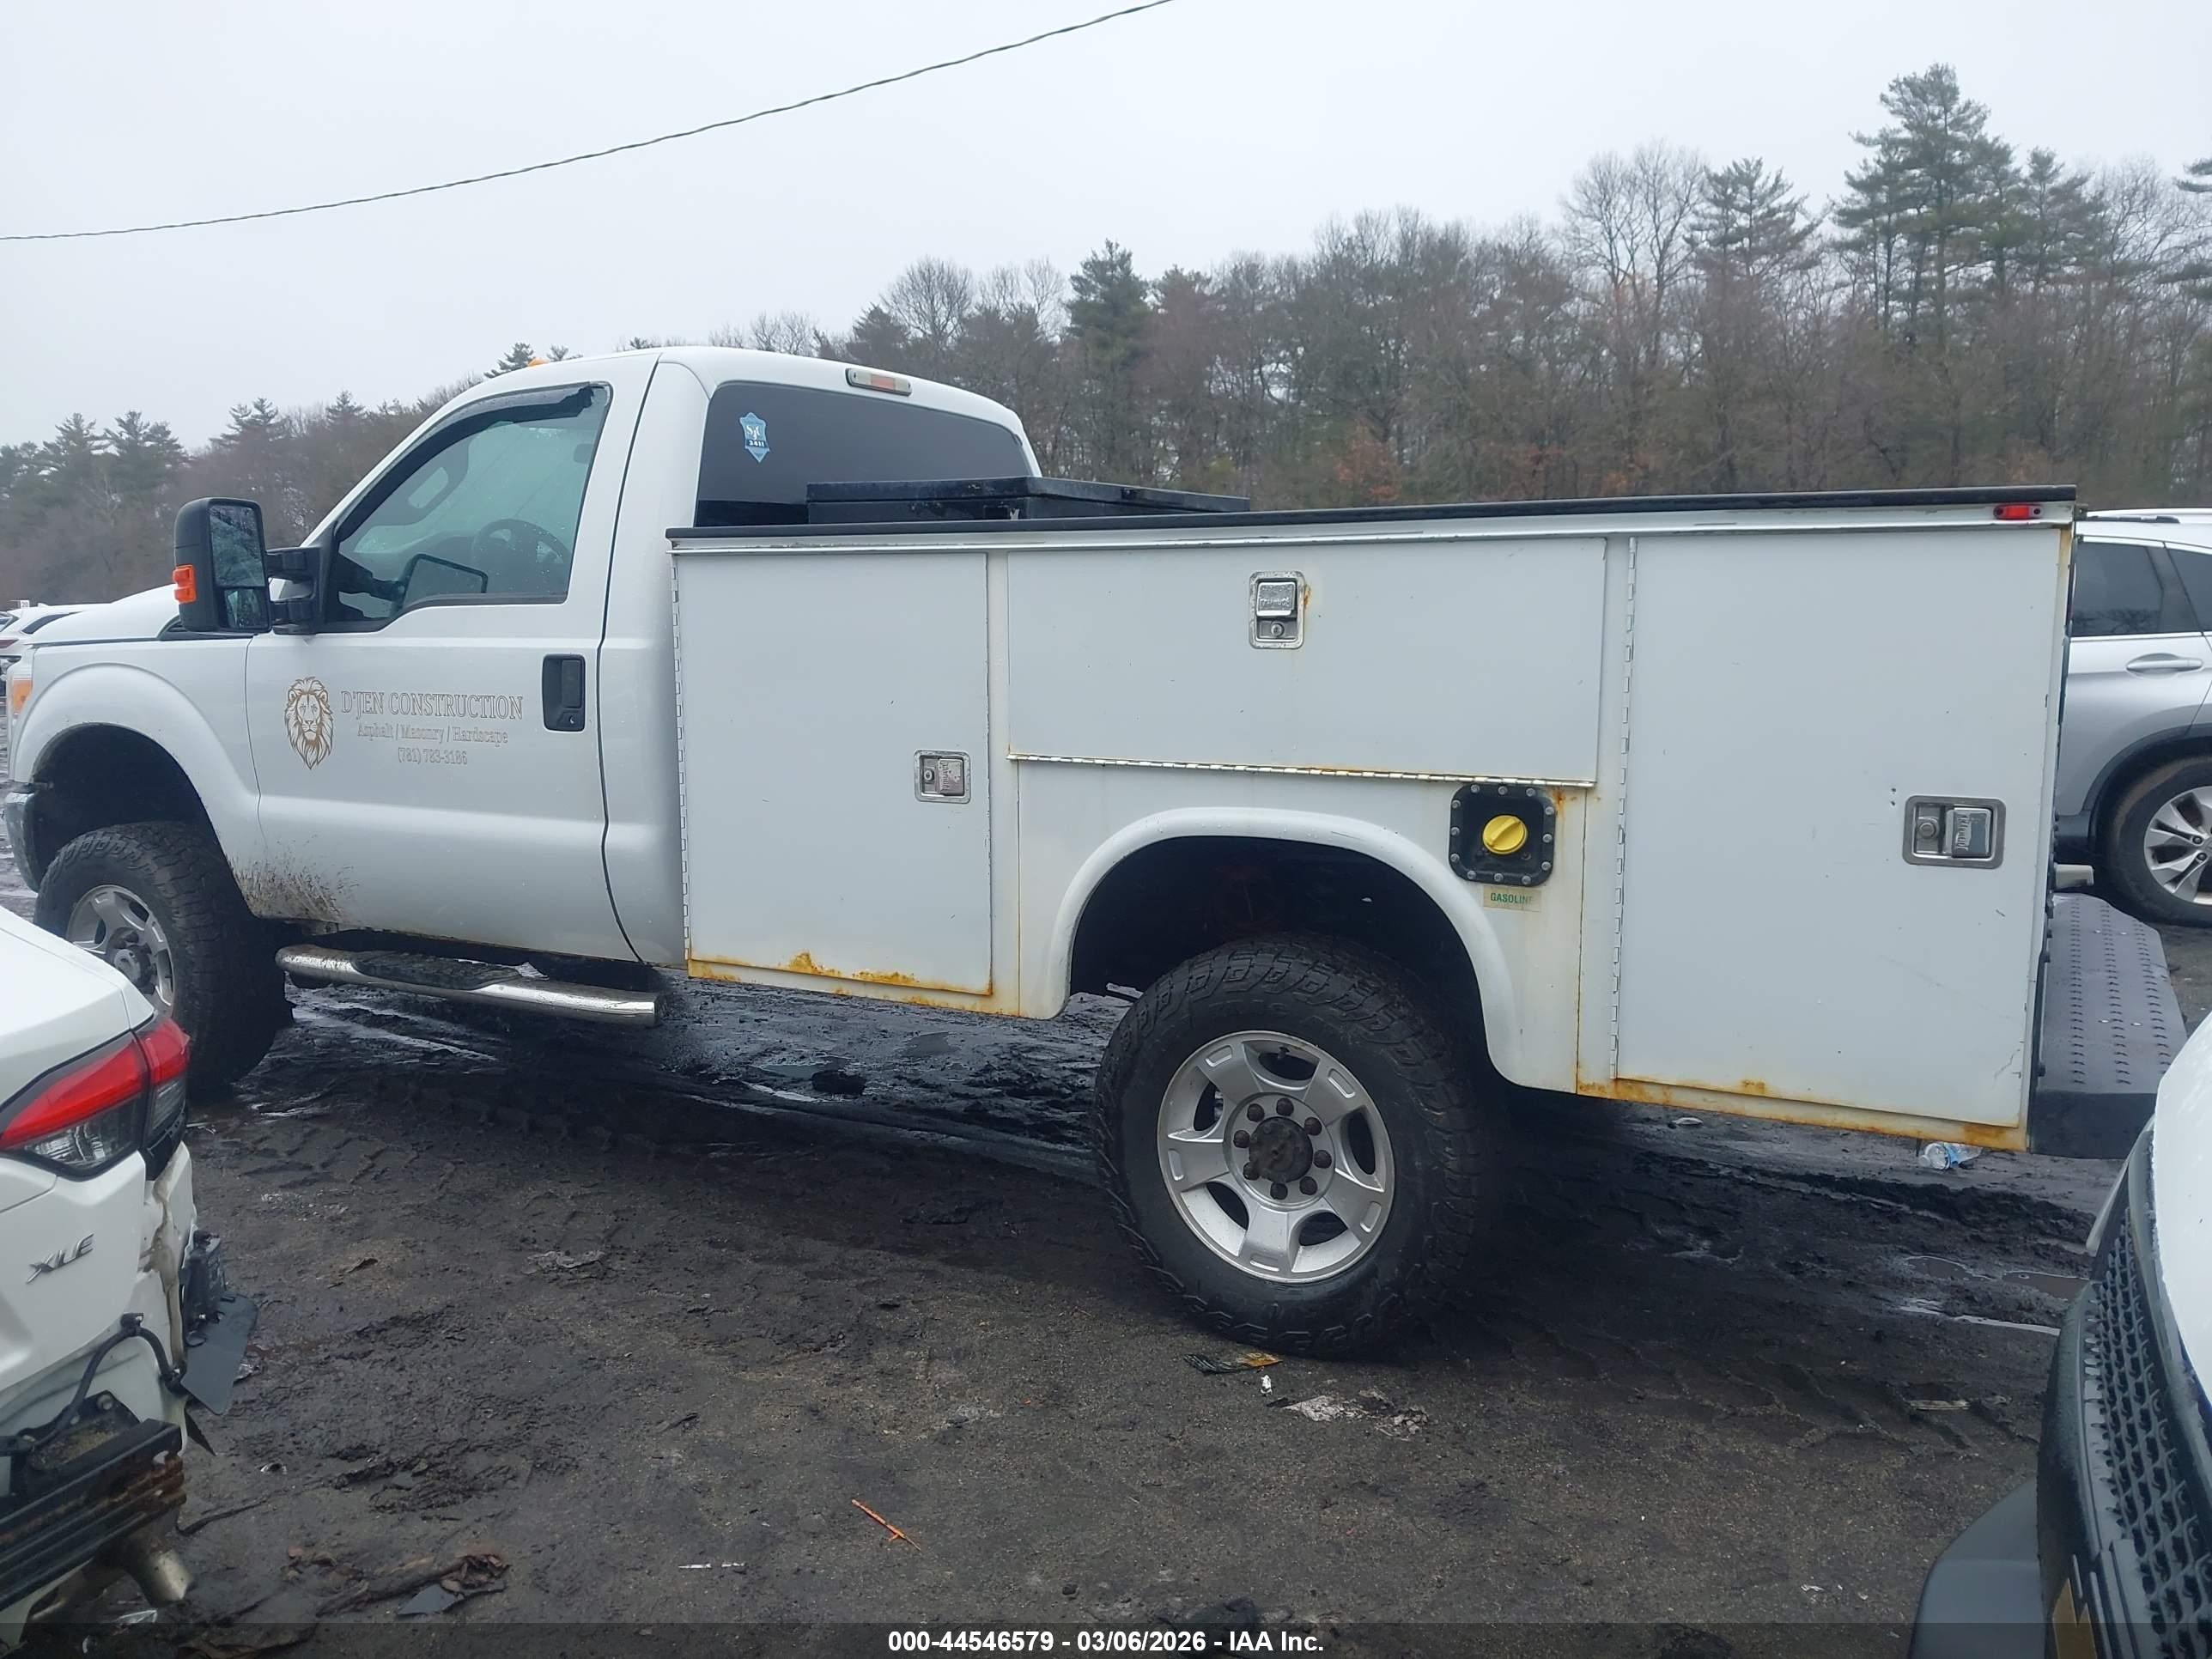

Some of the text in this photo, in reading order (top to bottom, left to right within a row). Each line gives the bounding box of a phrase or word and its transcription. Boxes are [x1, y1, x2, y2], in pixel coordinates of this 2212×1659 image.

[389, 692, 523, 720] CONSTRUCTION
[452, 726, 508, 748] Hardscape
[27, 1233, 94, 1284] XLE
